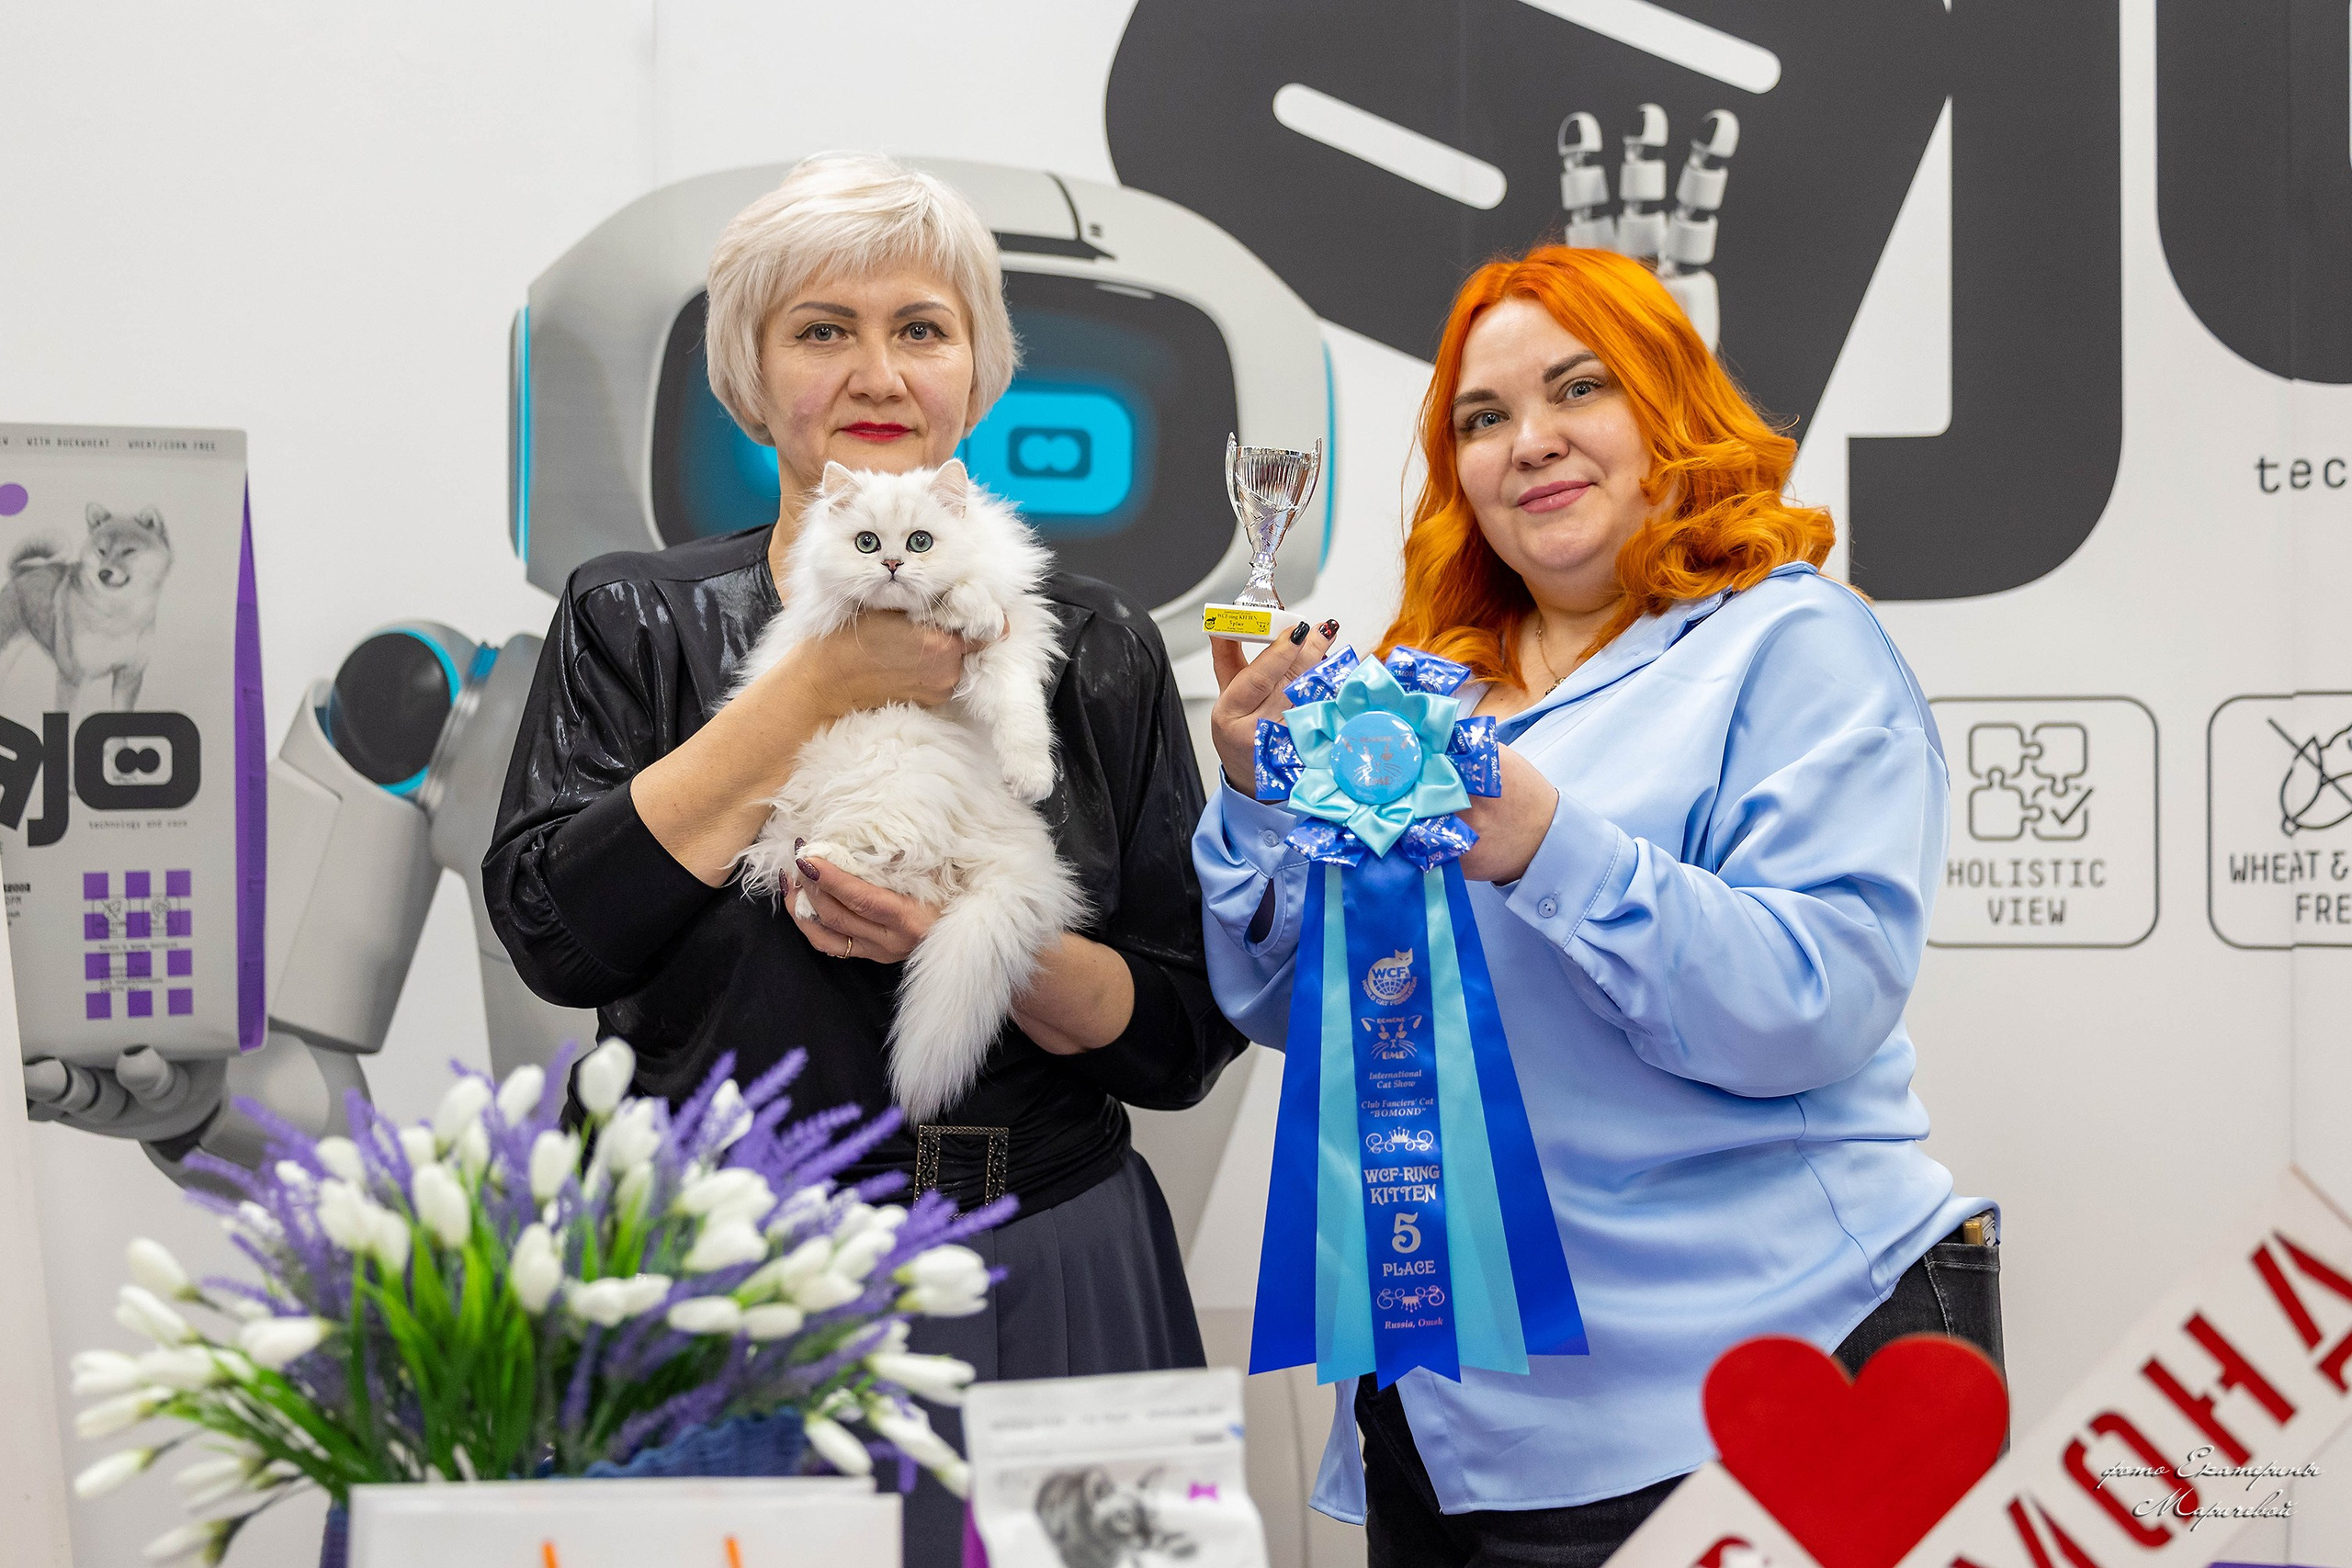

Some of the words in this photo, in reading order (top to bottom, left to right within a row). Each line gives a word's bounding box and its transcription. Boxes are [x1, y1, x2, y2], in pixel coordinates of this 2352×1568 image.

[2254, 457, 2346, 493] tec
[1946, 858, 2107, 888] HOLISTIC
[2229, 850, 2322, 885] WHEAT
[2330, 851, 2351, 882] &
[1987, 897, 2067, 925] VIEW
[1372, 966, 1408, 979] WCF
[1369, 1068, 1422, 1080] International
[1376, 1080, 1392, 1089] Cat
[1393, 1079, 1416, 1089] Show
[1361, 1100, 1380, 1110] Club
[1419, 1097, 1434, 1106] Cat
[1363, 1165, 1441, 1184] WCF-RING
[1370, 1183, 1437, 1205] KITTEN
[1391, 1212, 1421, 1254] 5
[1382, 1259, 1436, 1277] PLACE
[1385, 1319, 1416, 1329] Russia,
[1418, 1317, 1443, 1327] Omsk
